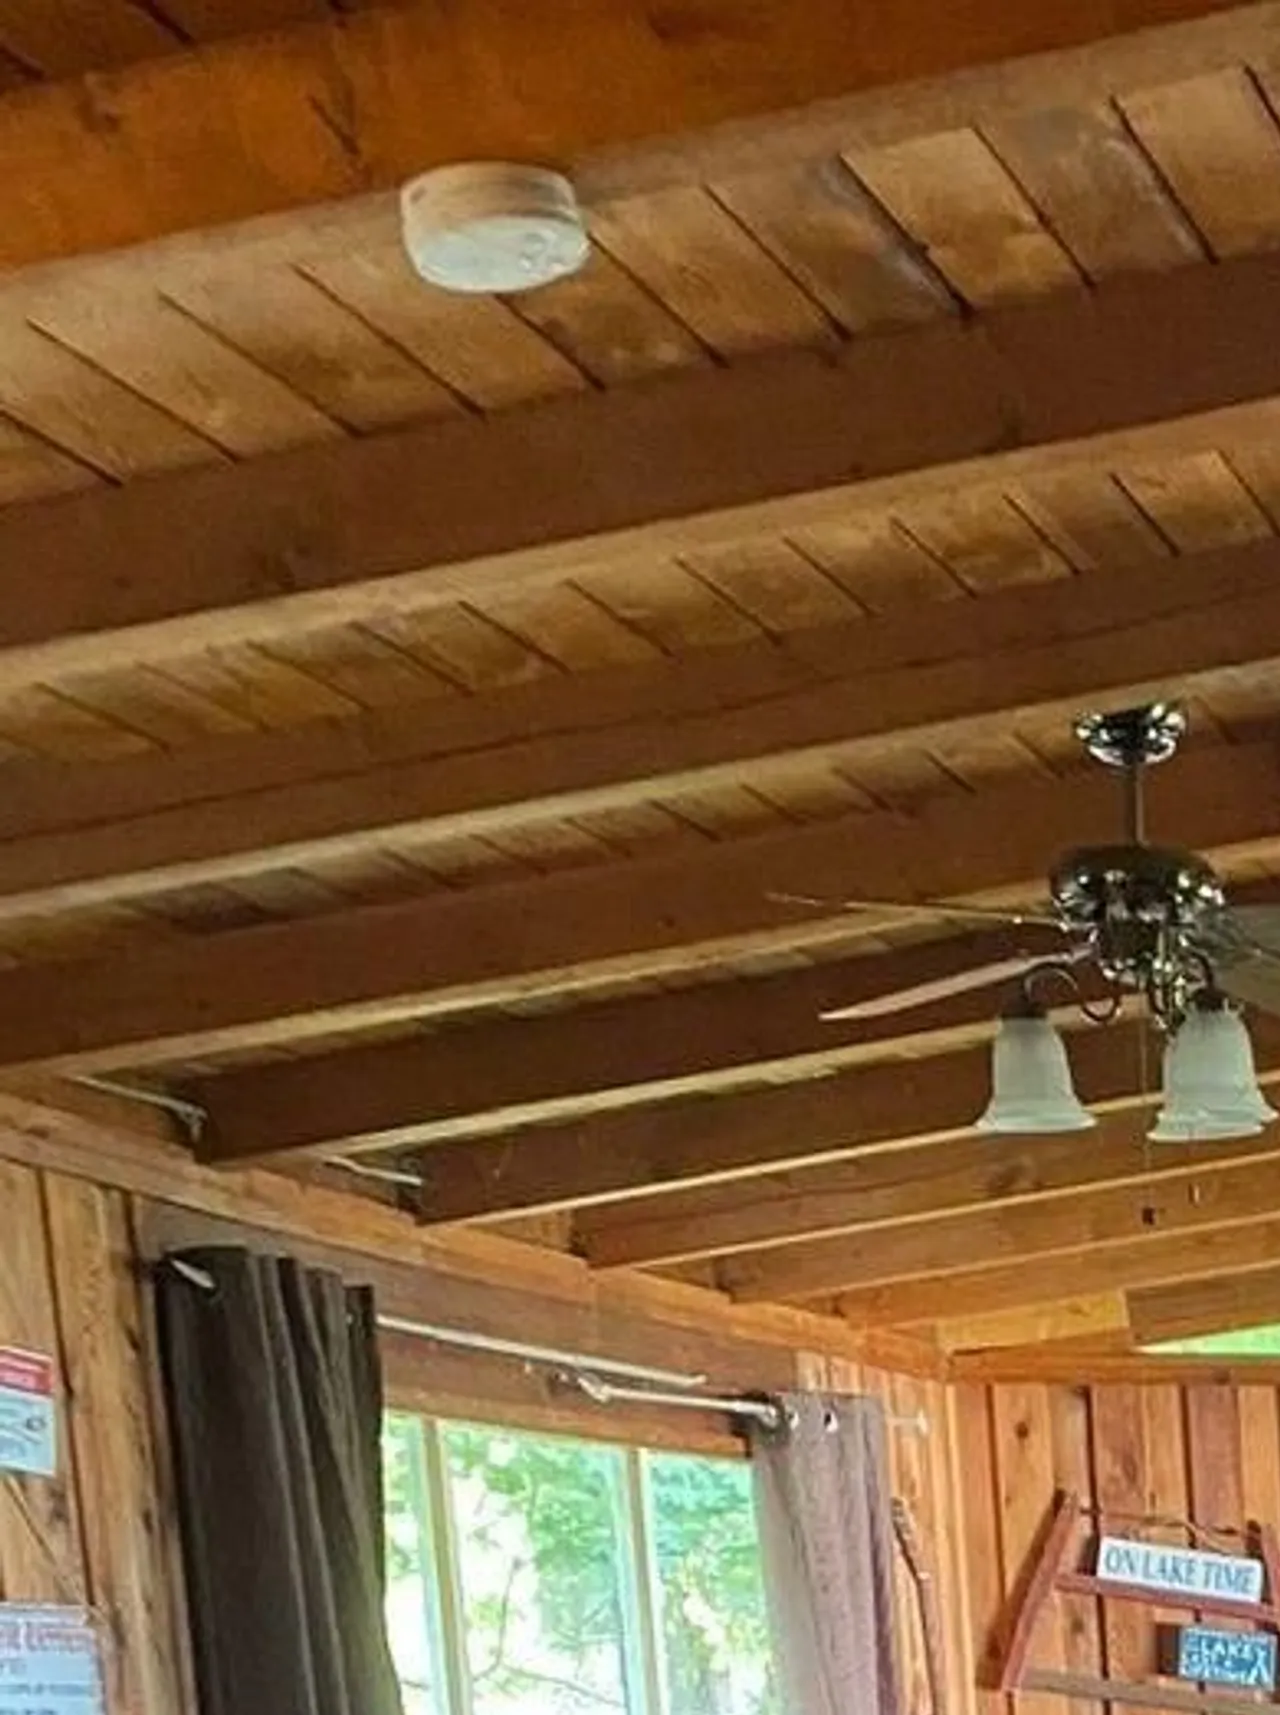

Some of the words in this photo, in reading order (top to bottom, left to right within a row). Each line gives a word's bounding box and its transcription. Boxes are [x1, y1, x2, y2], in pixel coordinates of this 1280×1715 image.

[1104, 1546, 1138, 1574] ON
[1144, 1550, 1197, 1586] LAKE
[1201, 1561, 1257, 1595] TIME
